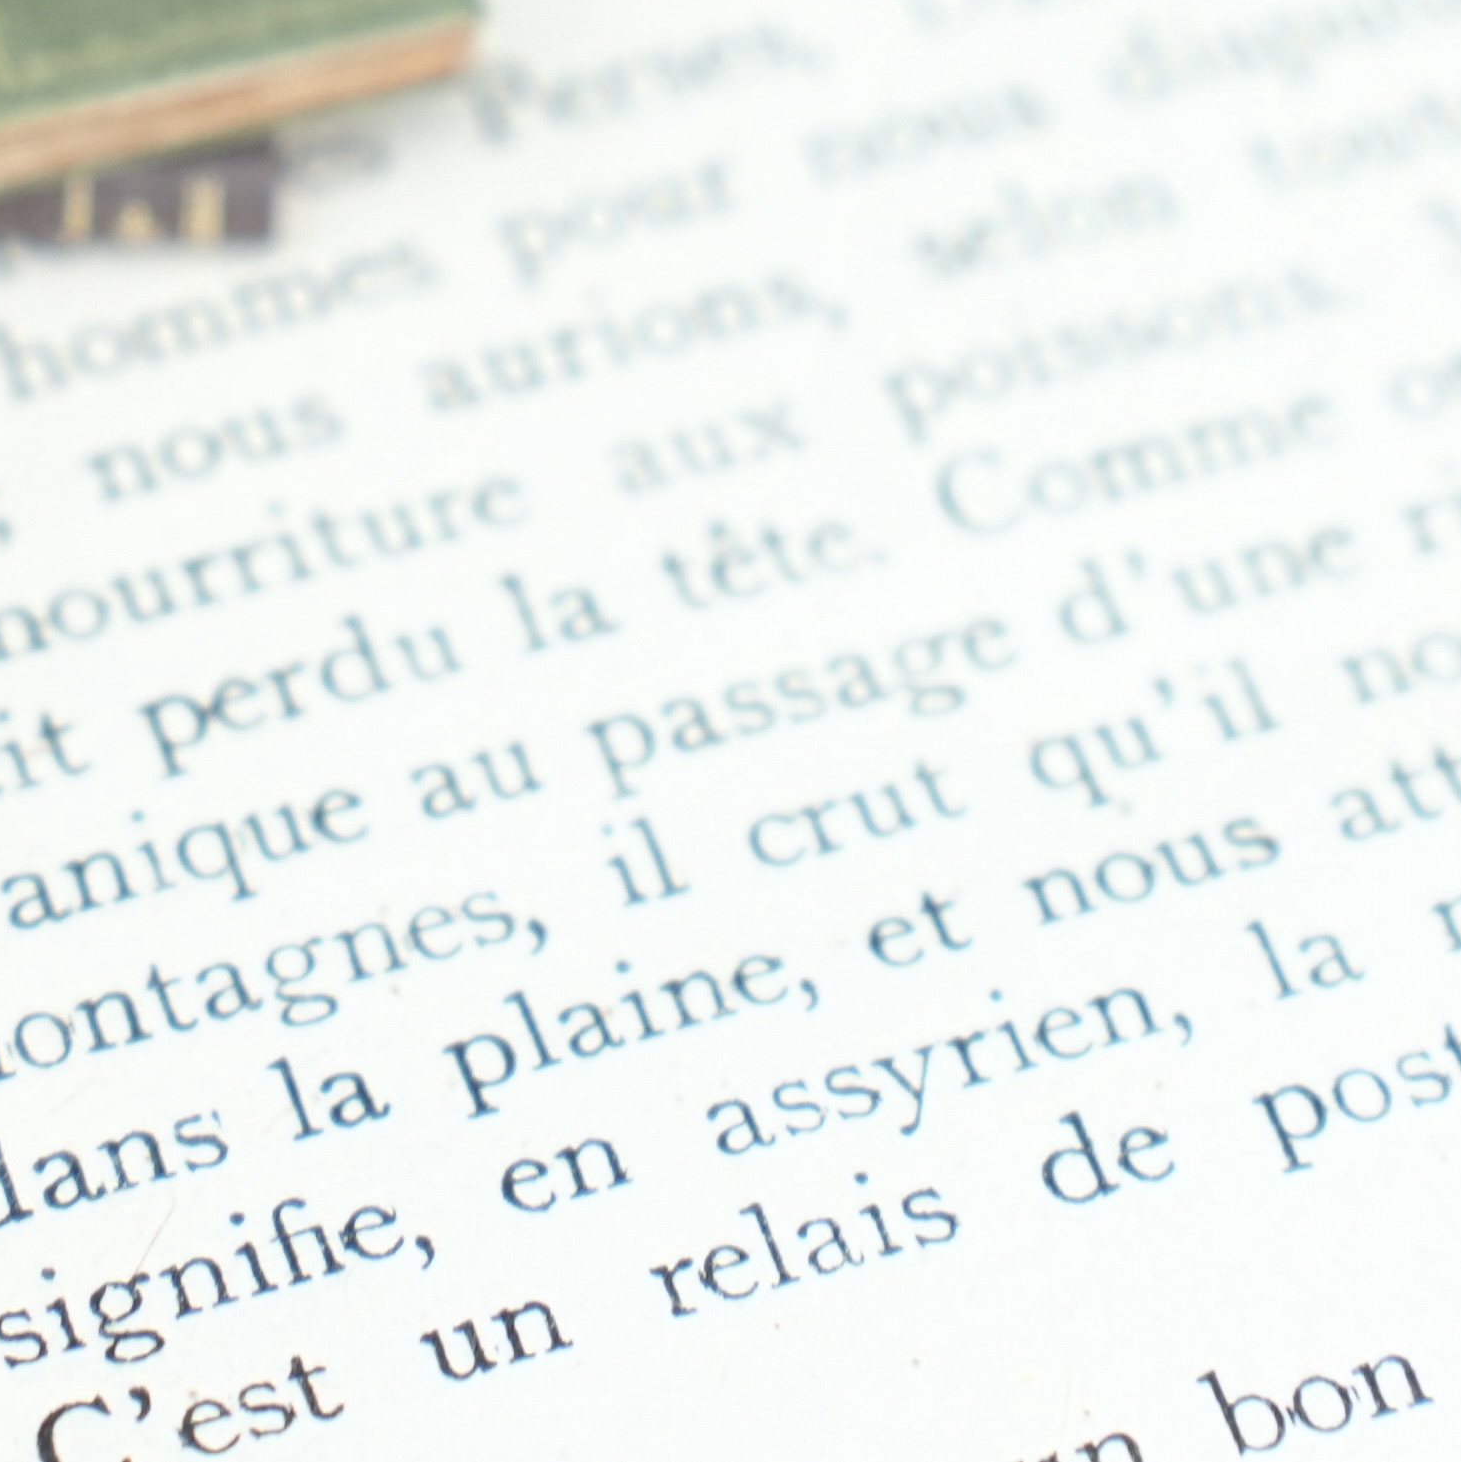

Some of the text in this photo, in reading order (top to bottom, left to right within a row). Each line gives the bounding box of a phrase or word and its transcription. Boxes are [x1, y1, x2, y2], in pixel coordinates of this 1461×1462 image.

[80, 390, 350, 508] nous
[418, 267, 853, 419] aurions,
[611, 395, 811, 500] aux
[135, 609, 465, 782] perdu
[494, 567, 621, 657] la
[930, 387, 1340, 537] Comme
[406, 736, 546, 824] au
[581, 612, 1016, 803] passage
[1051, 521, 1358, 648] d'une
[604, 811, 691, 909] il
[742, 757, 958, 871] crut
[1025, 651, 1283, 811] qu'il
[265, 1052, 395, 1145] la
[440, 951, 823, 1122] plaine,
[863, 885, 976, 967] et
[1019, 812, 1286, 929] nous
[495, 1134, 634, 1216] en
[701, 983, 1197, 1160] assyrien,
[1241, 914, 1367, 1004] la
[34, 1353, 346, 1462] C'est
[415, 1295, 577, 1386] un
[648, 1170, 966, 1321] relais
[1036, 1106, 1179, 1209] de
[1193, 1349, 1435, 1460] bon
